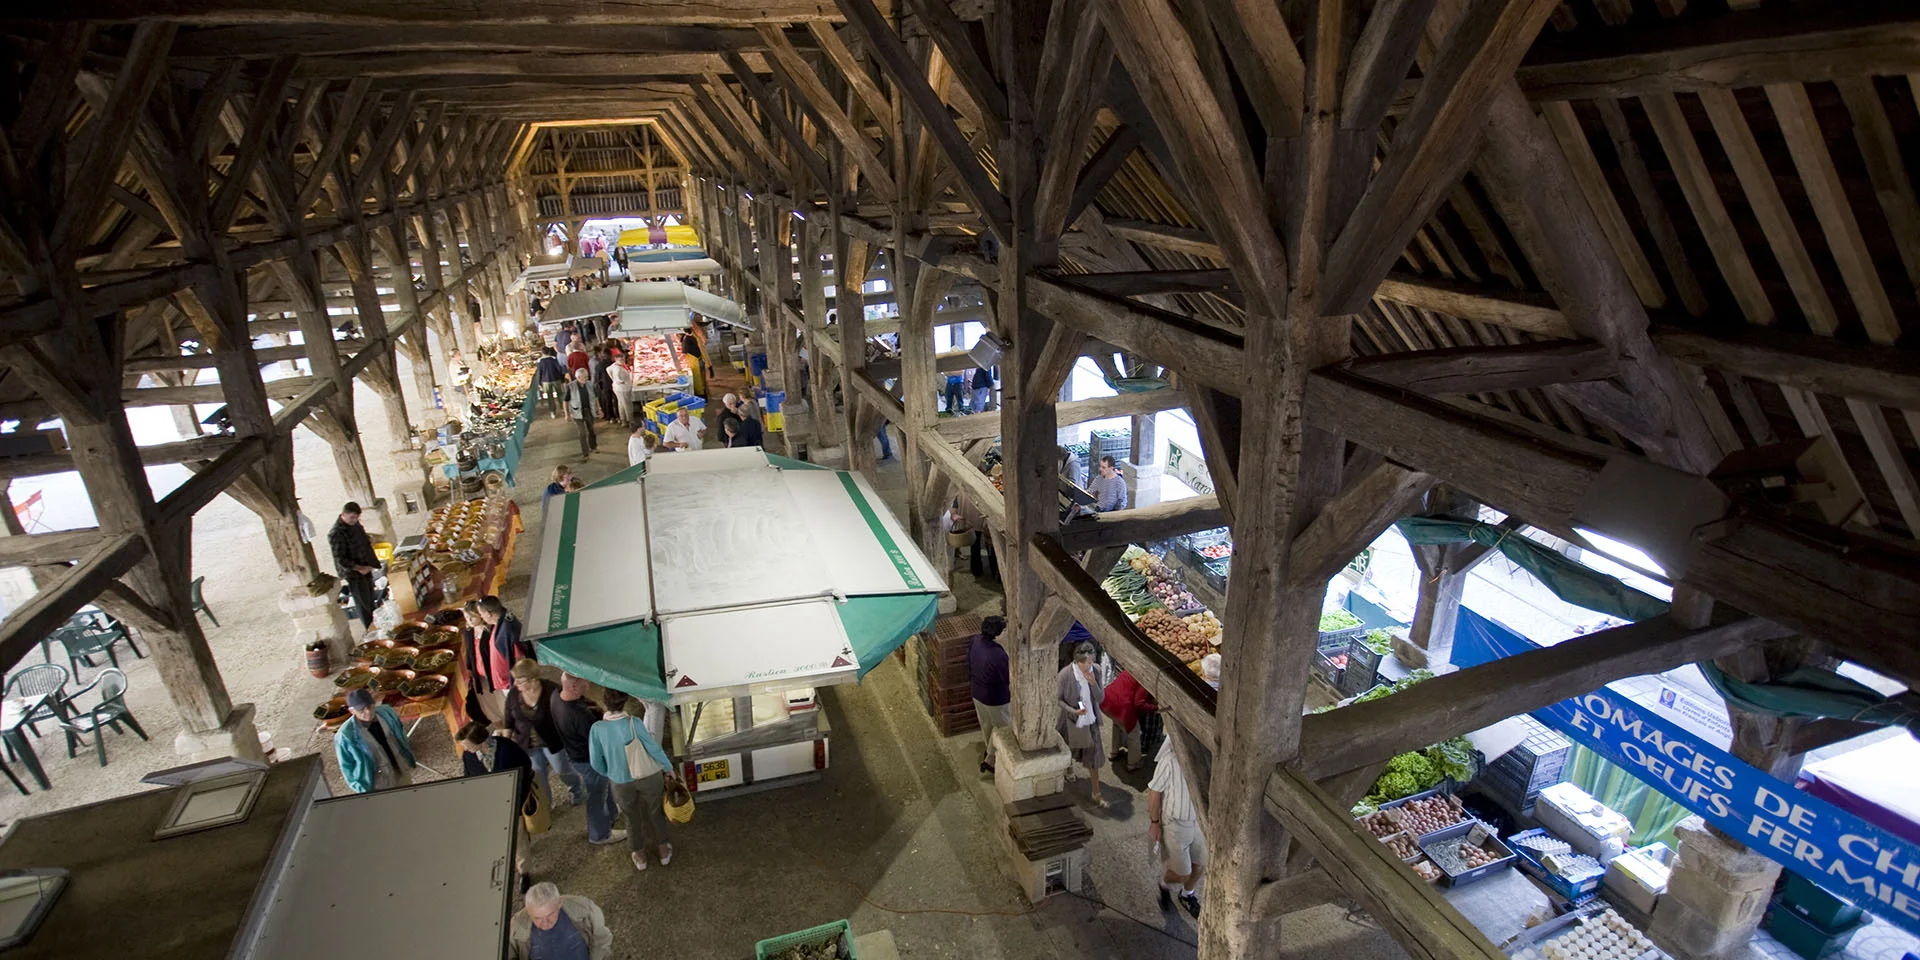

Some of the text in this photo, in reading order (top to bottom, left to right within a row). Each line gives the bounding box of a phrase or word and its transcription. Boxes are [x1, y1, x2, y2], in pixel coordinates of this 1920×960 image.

[703, 760, 726, 772] 5638
[1570, 708, 1605, 740] ET
[1620, 741, 1732, 818] OEUFS
[1754, 786, 1817, 835] DE
[1838, 833, 1920, 892] CH
